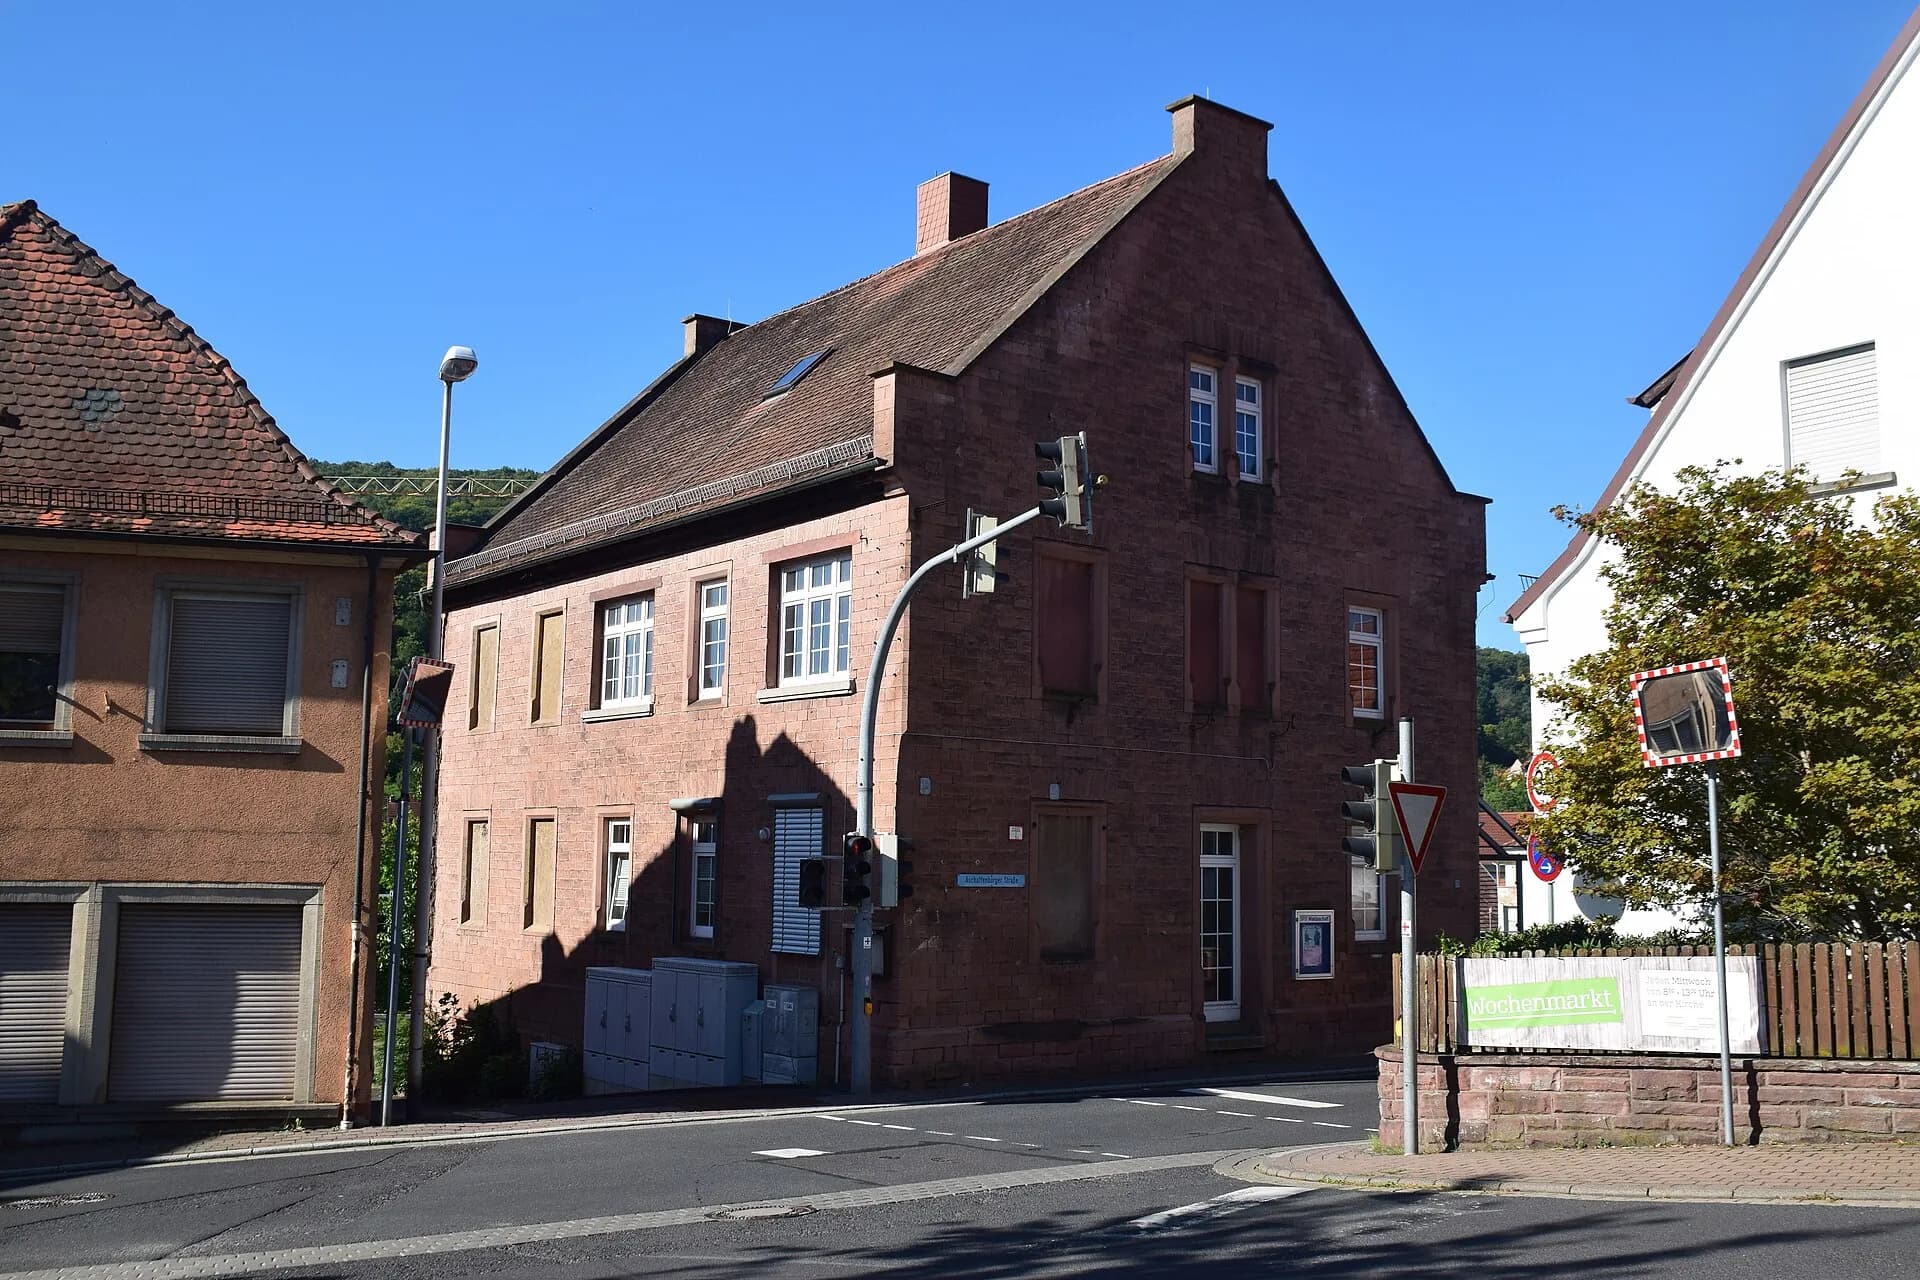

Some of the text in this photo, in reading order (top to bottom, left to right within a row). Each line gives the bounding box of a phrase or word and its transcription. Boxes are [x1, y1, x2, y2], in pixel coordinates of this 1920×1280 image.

[1003, 876, 1019, 885] Straße
[1671, 976, 1711, 986] Mittwoch
[1698, 988, 1715, 998] Uhr
[1469, 988, 1613, 1015] Wochenmarkt
[1675, 1000, 1705, 1009] Kirche
